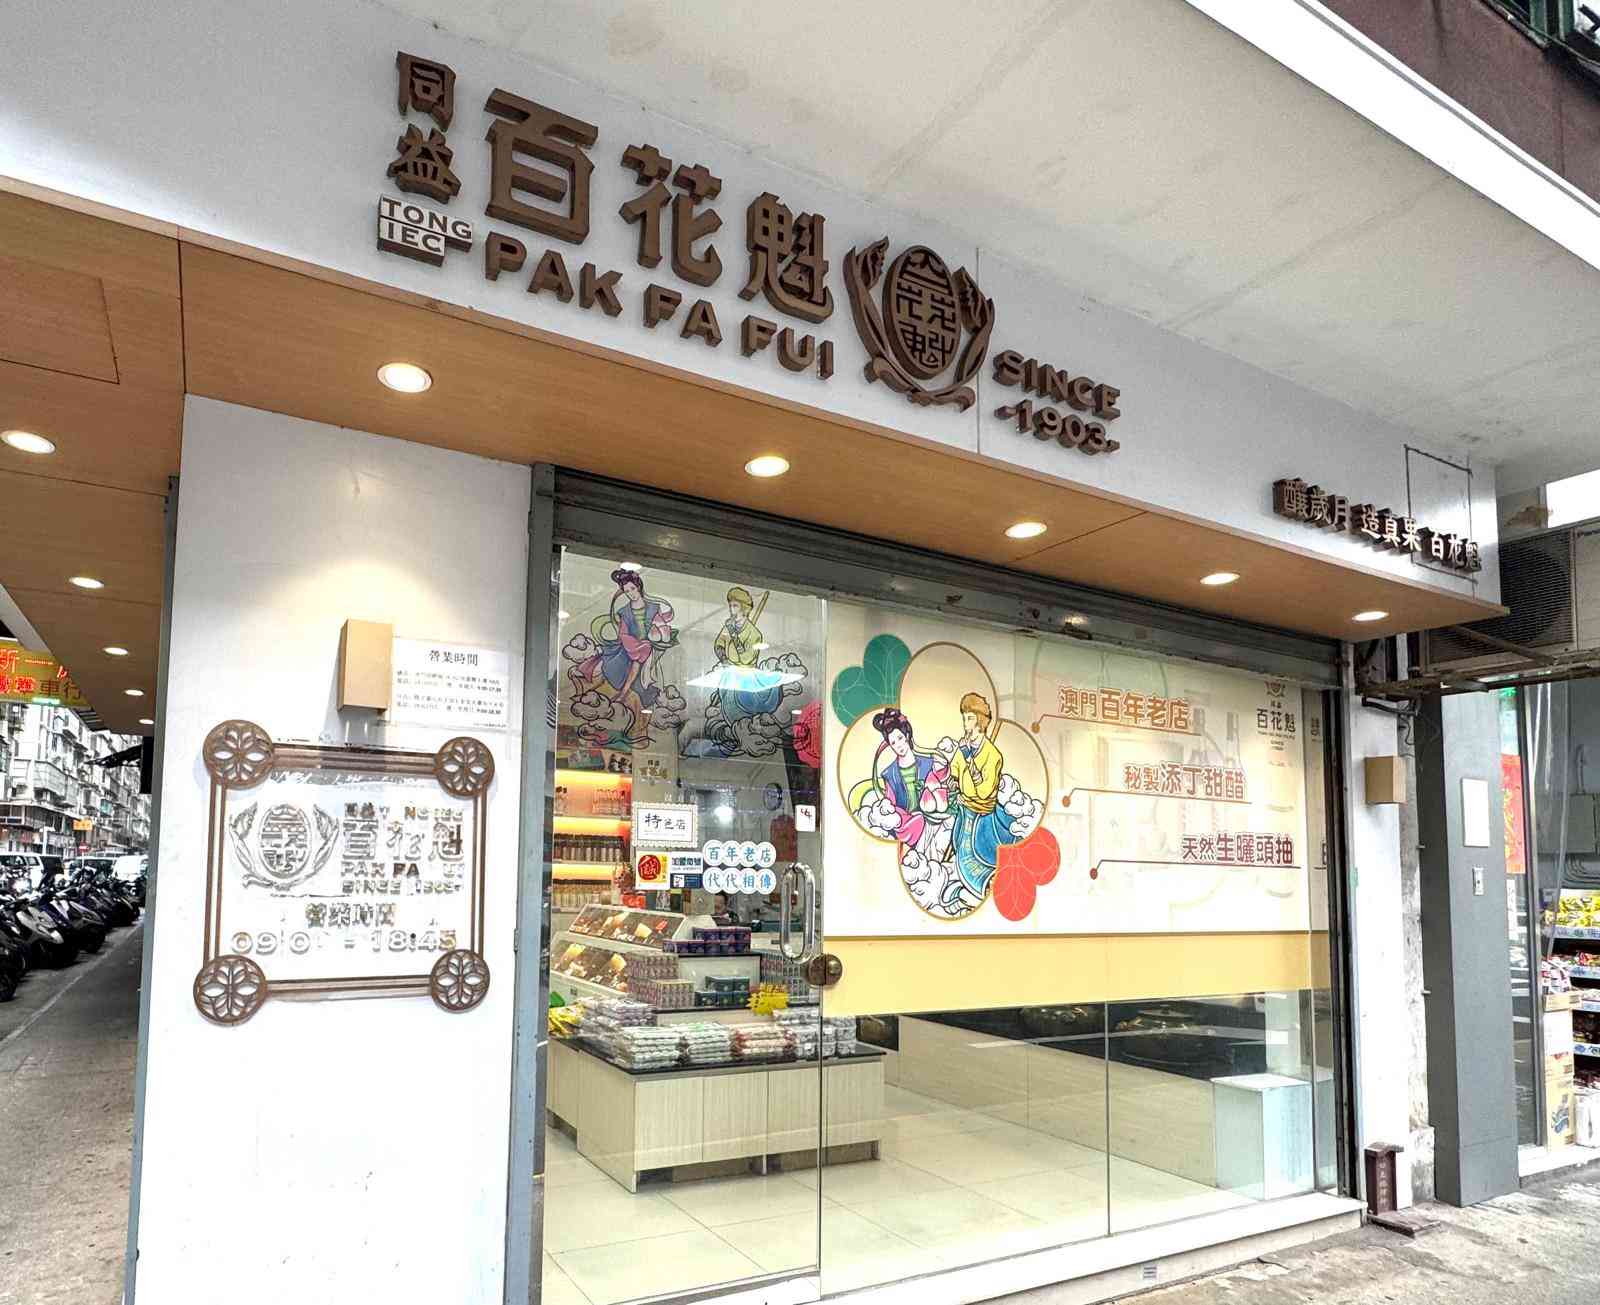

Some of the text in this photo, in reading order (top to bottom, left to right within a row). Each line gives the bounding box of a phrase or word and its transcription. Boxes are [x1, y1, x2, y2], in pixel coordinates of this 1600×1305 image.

[387, 50, 462, 204] 同益
[382, 197, 472, 240] TONG
[484, 87, 835, 325] 百花魁
[385, 222, 443, 255] IEC
[485, 231, 834, 380] PAK FA FUI
[992, 349, 1121, 421] SINCE
[429, 649, 479, 667] 營業時間
[1059, 687, 1189, 730] 澳門百年老店
[1256, 708, 1296, 733] 百花魁
[1124, 762, 1245, 800] 秘製添丁甜醋
[708, 846, 772, 863] 百年老店
[1182, 833, 1293, 865] 天然生曬頭抽
[393, 862, 420, 881] FA
[708, 872, 771, 889] 代代相傳
